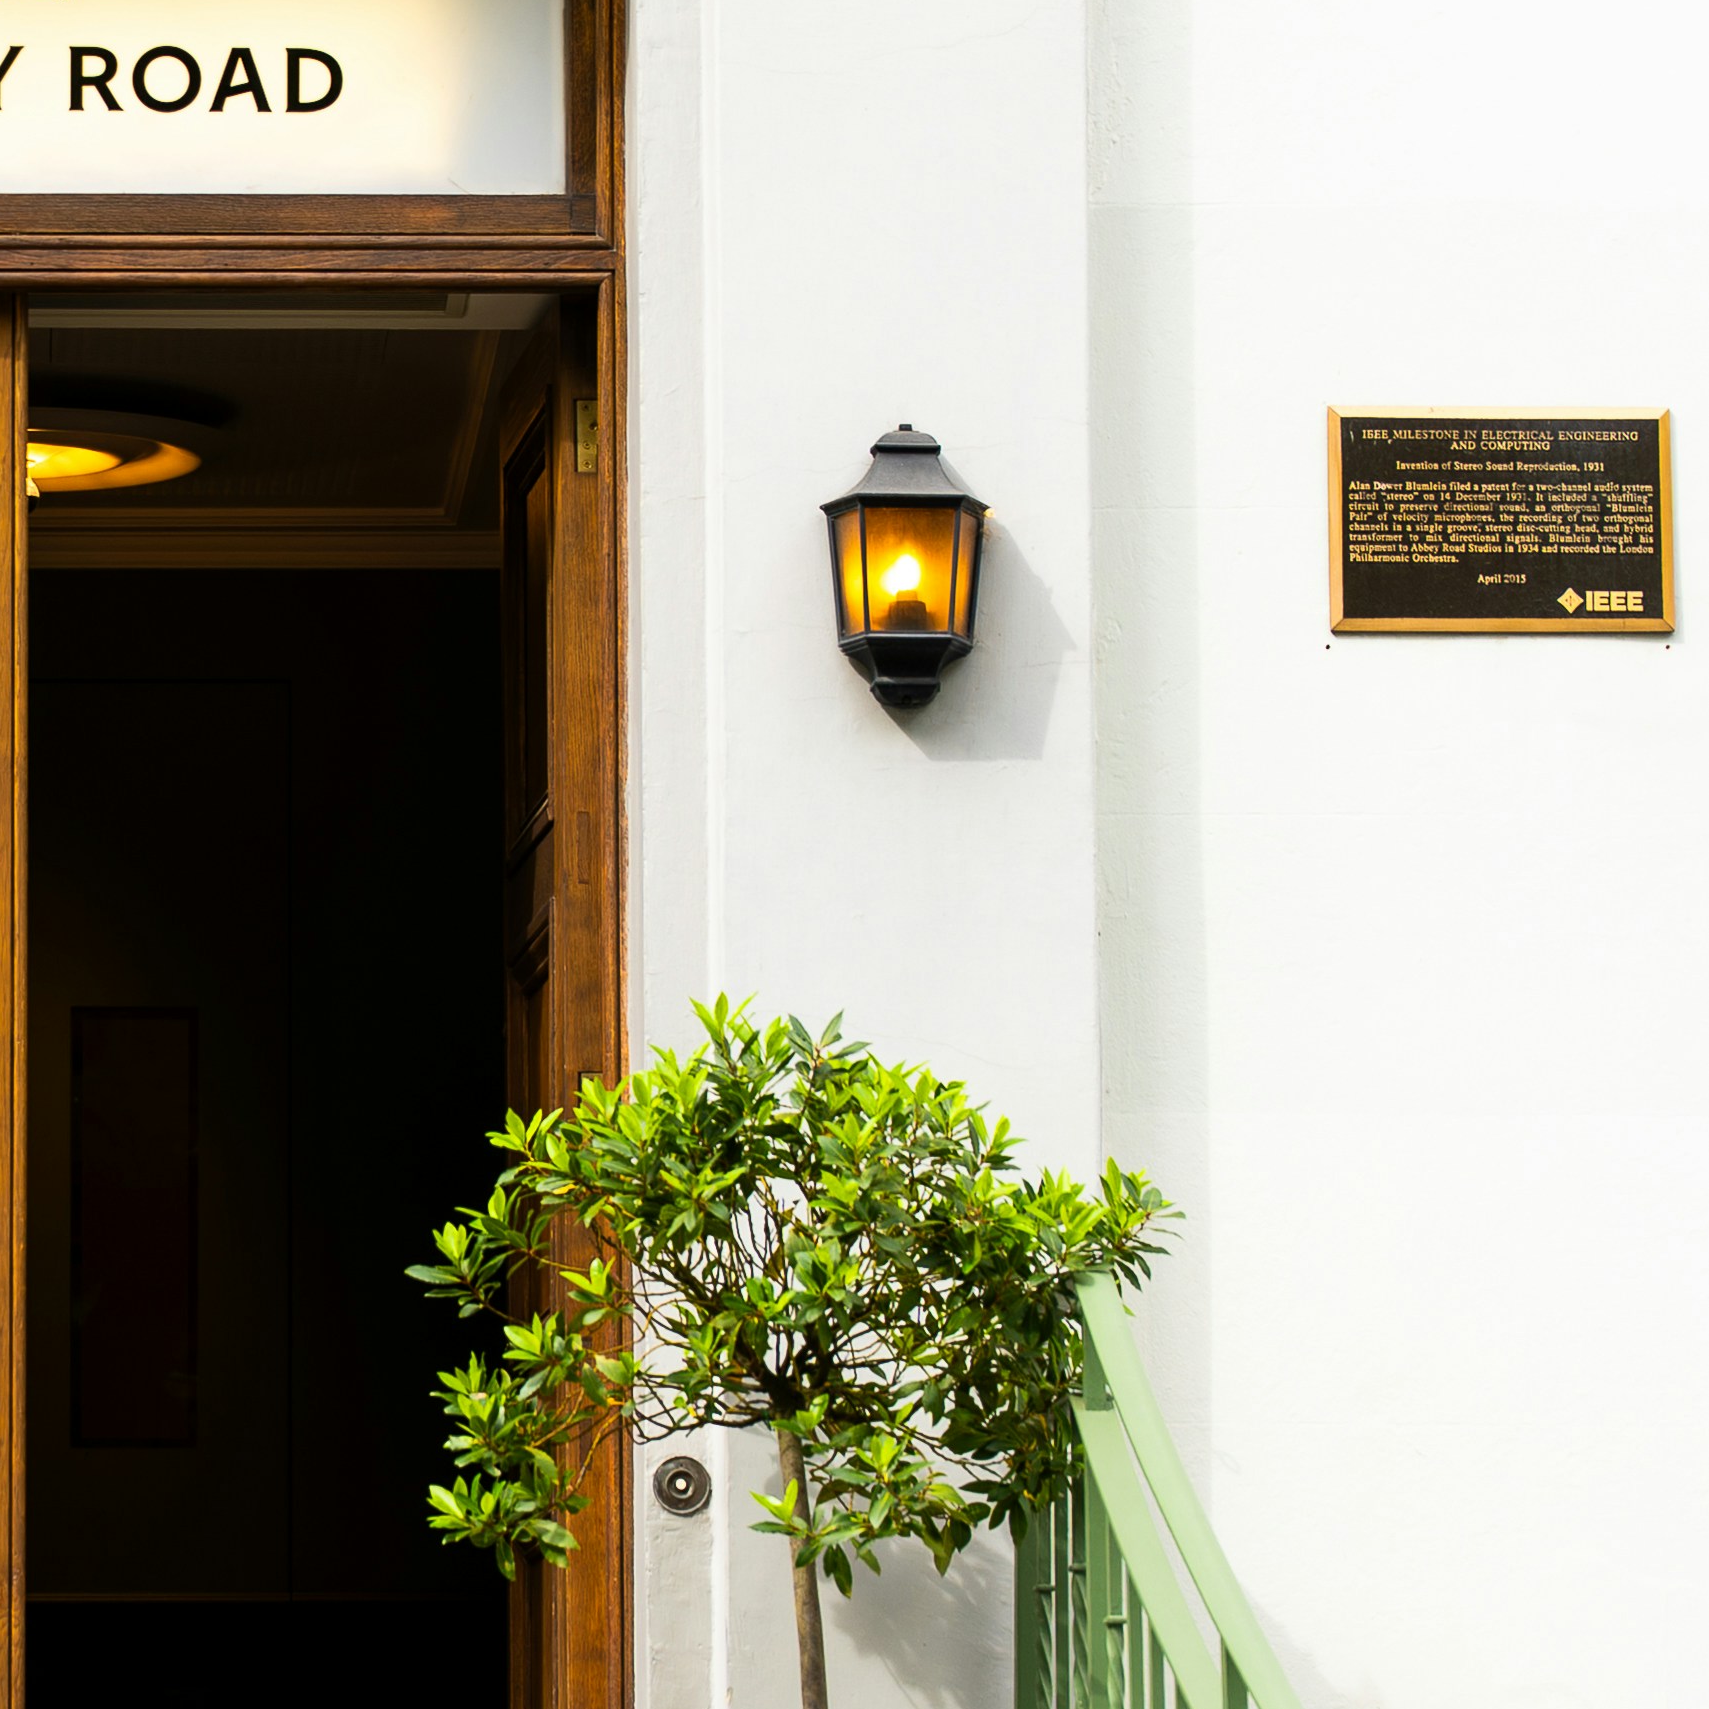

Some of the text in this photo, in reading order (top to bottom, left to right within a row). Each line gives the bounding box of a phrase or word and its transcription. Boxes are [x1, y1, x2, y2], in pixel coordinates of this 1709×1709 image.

[68, 44, 345, 113] ROAD
[1362, 430, 1638, 441] IEEE MILESTONE IN ELECTRICAL ENGINEERING
[1450, 441, 1550, 450] AND COMPUTING
[1396, 461, 1604, 473] Invention of Stereo Sound Reproduction, 1931
[1349, 482, 1370, 491] Alan
[1373, 482, 1403, 491] Dower
[1405, 482, 1447, 491] Blumlein
[1450, 482, 1471, 491] filed
[1481, 483, 1509, 493] patent
[1536, 483, 1591, 492] two-channel
[1594, 483, 1618, 492] audio
[1622, 484, 1653, 493] system
[1440, 492, 1450, 501] 14
[1455, 493, 1501, 501] December
[1536, 493, 1543, 501] It
[1548, 493, 1587, 502] included
[1349, 502, 1379, 511] circuit
[1400, 504, 1438, 512] preserve
[1444, 502, 1493, 511] directional
[1499, 503, 1529, 512] sound,
[1377, 513, 1388, 521] of
[1393, 513, 1429, 523] velocity
[1500, 514, 1514, 522] the
[1519, 514, 1562, 524] recording
[1568, 514, 1577, 522] of
[1604, 514, 1653, 525] orthogonal
[1349, 523, 1388, 531] channels
[1393, 523, 1402, 531] in
[1416, 523, 1443, 533] single
[1485, 524, 1512, 532] stereo
[1575, 525, 1599, 533] head,
[1603, 525, 1619, 533] and
[1623, 525, 1653, 535] hybrid
[1349, 533, 1403, 542] transformer
[1426, 534, 1443, 542] mix
[1450, 533, 1500, 542] directional
[1549, 535, 1591, 543] Blumlein
[1598, 535, 1633, 545] brought
[1640, 535, 1653, 543] his
[1349, 543, 1653, 554] equipment to Abbey Road Studios in 1934 and recorded the London
[1349, 553, 1459, 563] Philharmonic Orchestra.
[1477, 574, 1526, 585] April 2015
[1585, 591, 1644, 611] IEEE
